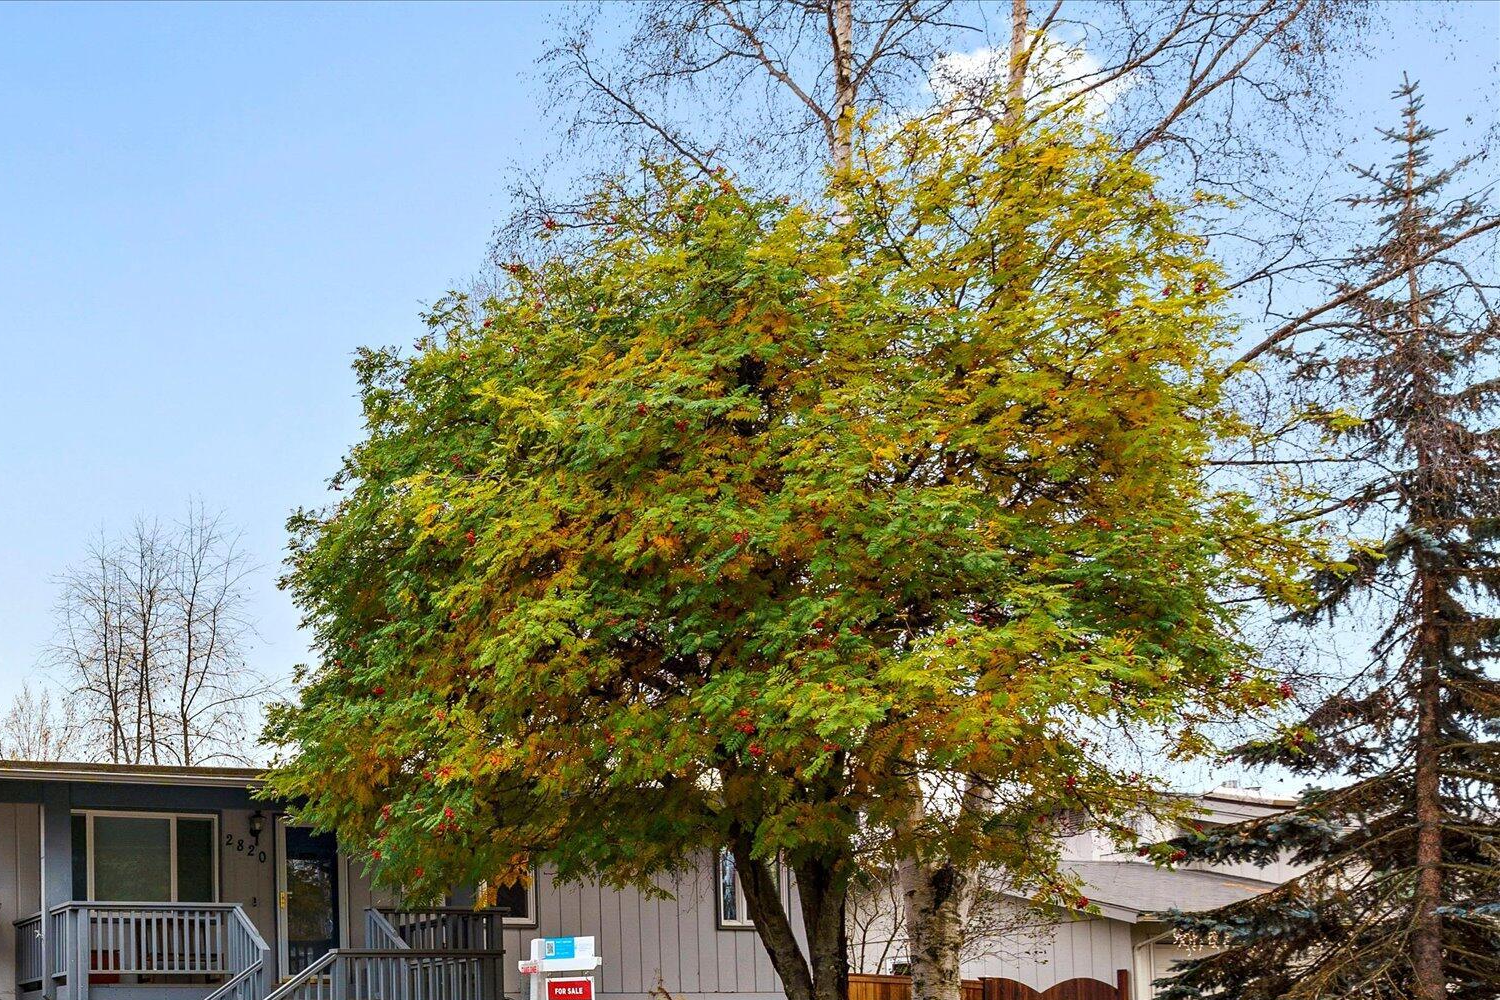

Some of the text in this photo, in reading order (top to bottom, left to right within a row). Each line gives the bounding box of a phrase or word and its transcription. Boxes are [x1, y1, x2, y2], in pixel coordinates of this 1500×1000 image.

[225, 833, 267, 863] 2820
[554, 987, 583, 995] FOR SALE
